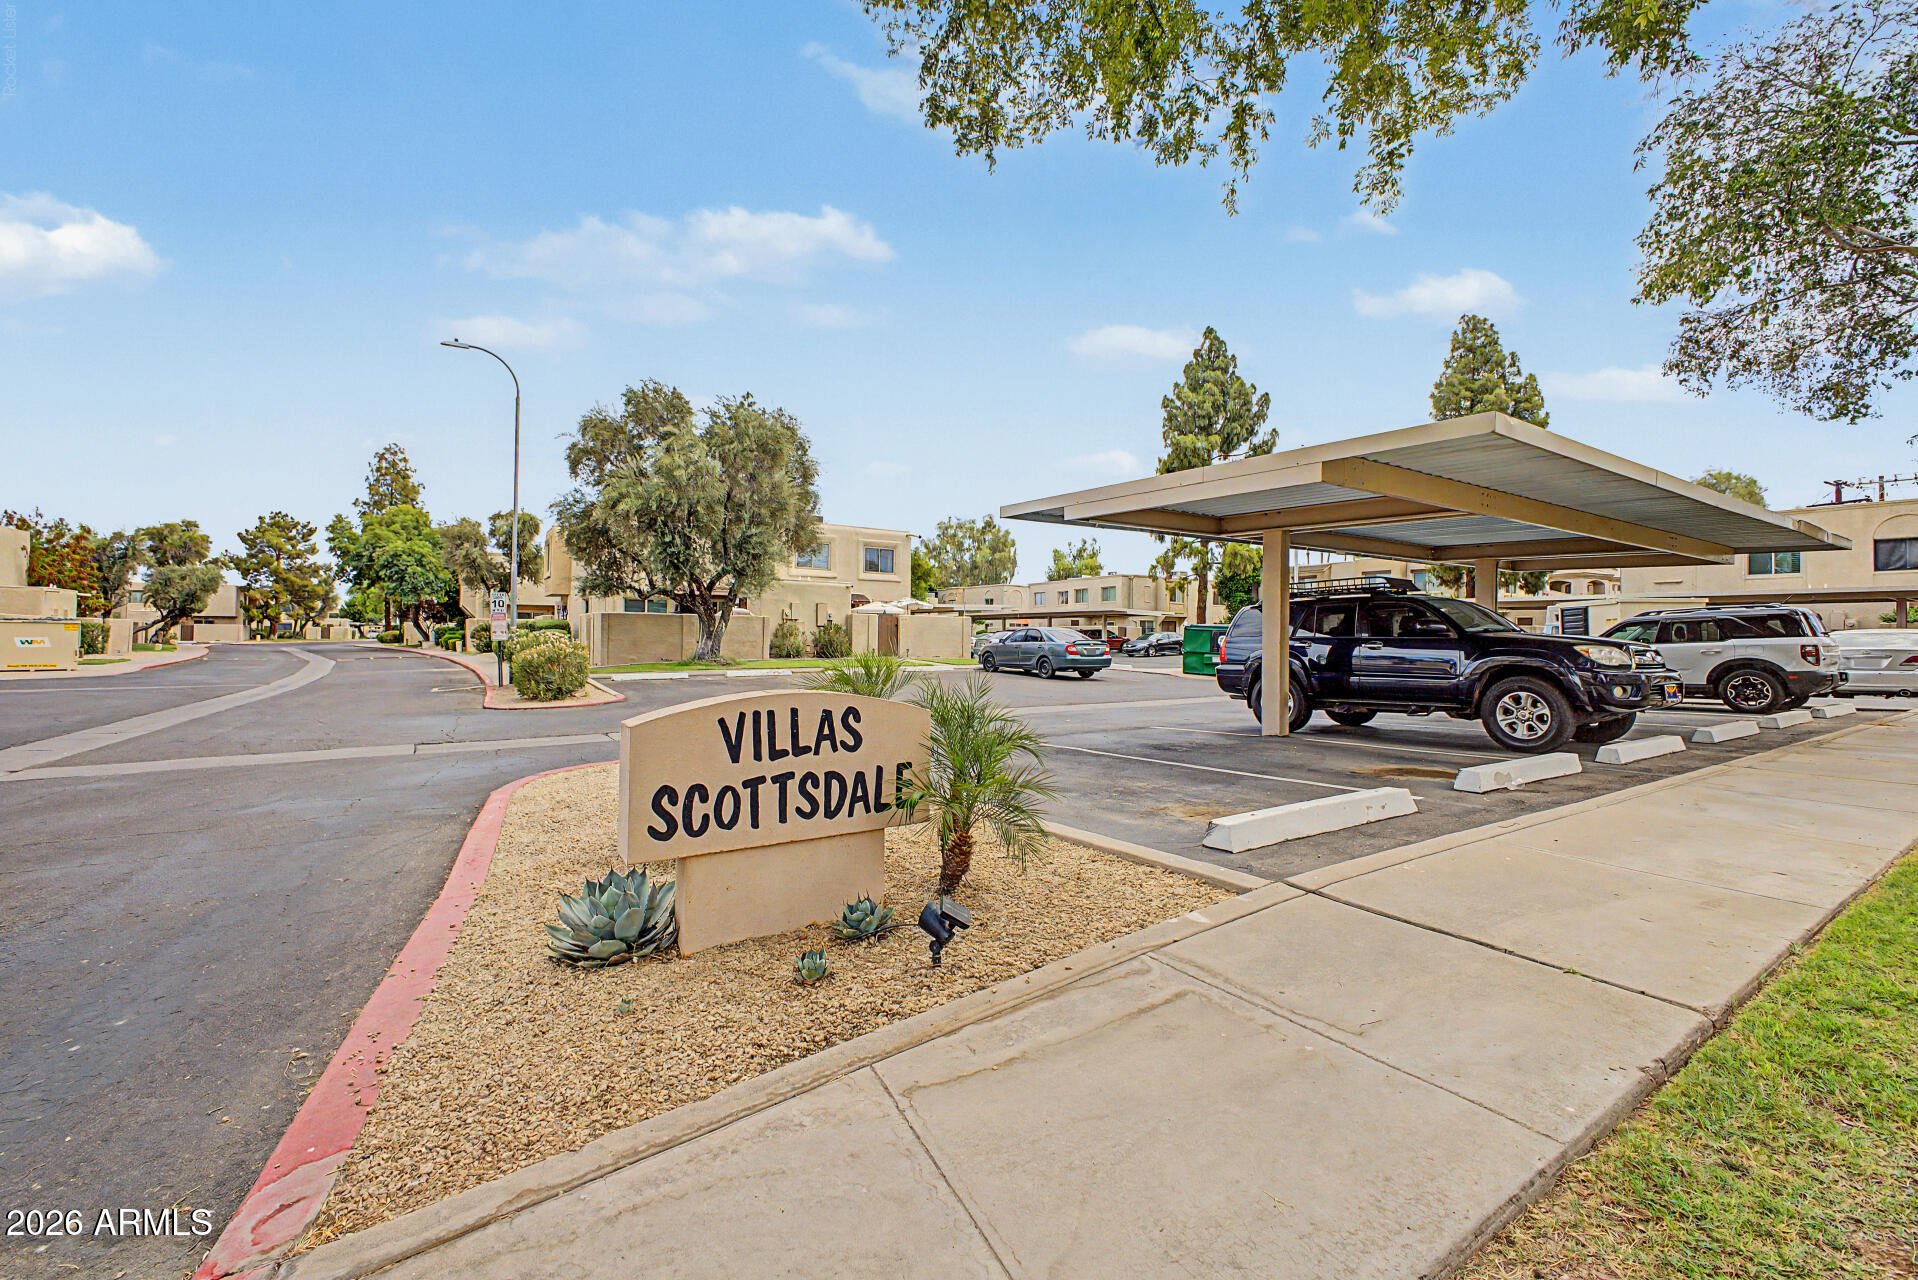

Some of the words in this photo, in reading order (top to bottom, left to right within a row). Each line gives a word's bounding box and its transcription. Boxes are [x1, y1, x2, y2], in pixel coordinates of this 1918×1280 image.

[491, 599, 505, 608] 10
[717, 706, 864, 764] VILLAS
[647, 761, 913, 842] SCOTTSDALE
